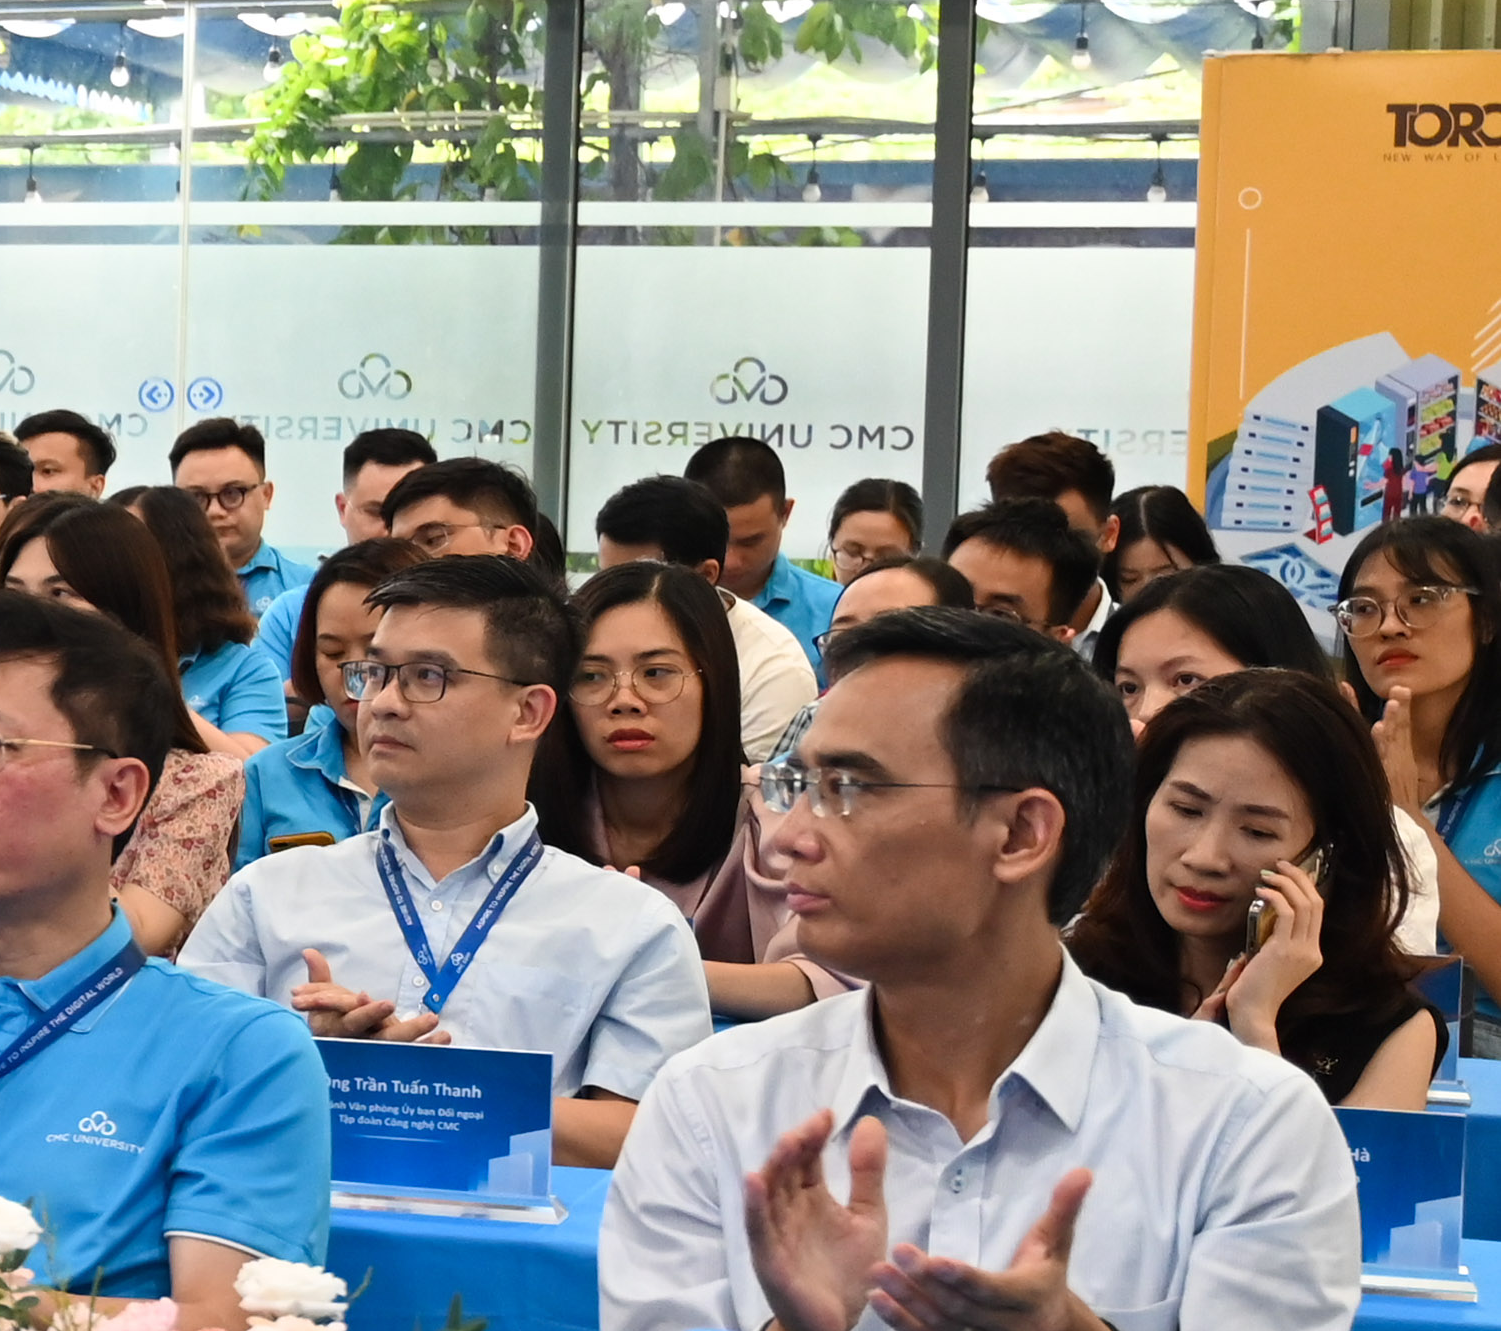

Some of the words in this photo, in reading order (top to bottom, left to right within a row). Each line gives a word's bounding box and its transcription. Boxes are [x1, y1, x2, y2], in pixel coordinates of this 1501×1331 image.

[1383, 151, 1412, 162] NEW
[1424, 151, 1453, 162] WAY
[354, 1075, 388, 1092] Trần
[391, 1078, 429, 1095] Tuấn
[432, 1082, 482, 1099] Thanh
[46, 1133, 70, 1143] CMC
[72, 1134, 146, 1155] UNIVERSITY
